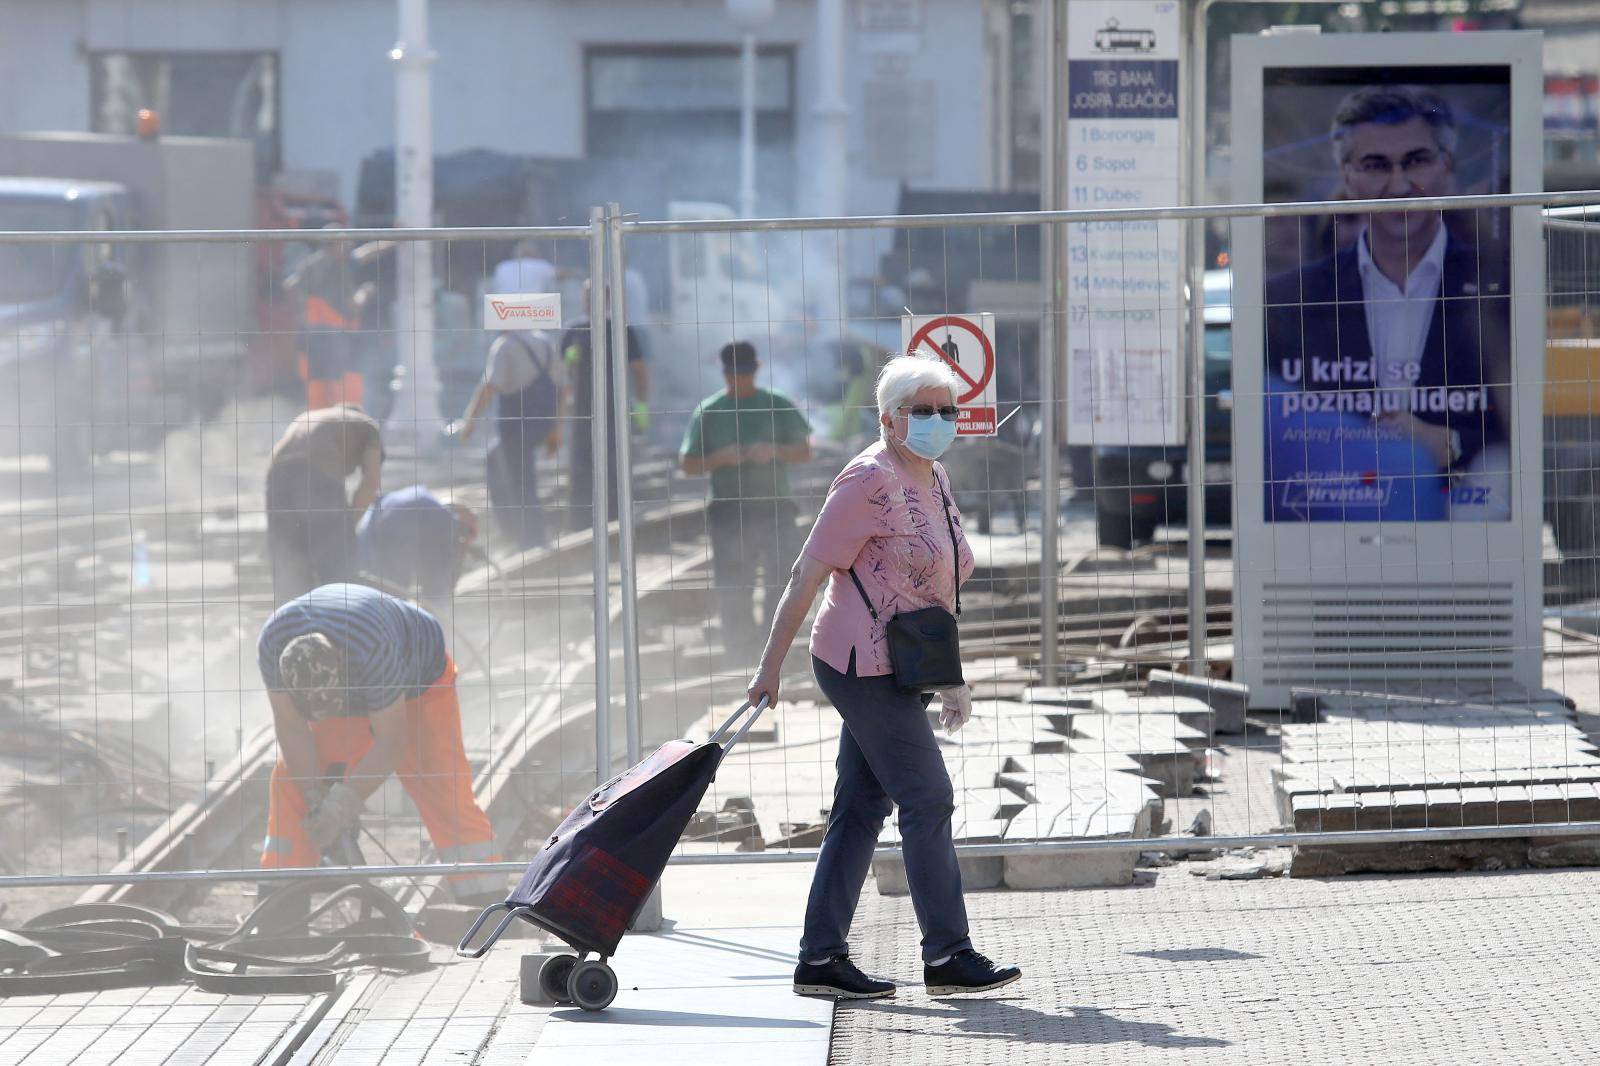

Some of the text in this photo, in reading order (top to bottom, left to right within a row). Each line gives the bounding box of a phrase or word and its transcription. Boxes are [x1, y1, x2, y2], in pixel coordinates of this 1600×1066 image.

[1092, 70, 1155, 87] TRG BANA
[1090, 127, 1156, 144] Borongaj
[1076, 154, 1136, 173] 6 Sopot
[1074, 186, 1143, 203] 11 Dubec
[1071, 245, 1087, 262] 13
[1073, 276, 1088, 291] 14
[1281, 356, 1421, 382] U krizi se
[1282, 386, 1488, 417] poznaju lideri
[1282, 426, 1333, 444] Andrej
[1309, 485, 1385, 502] Hrvatska
